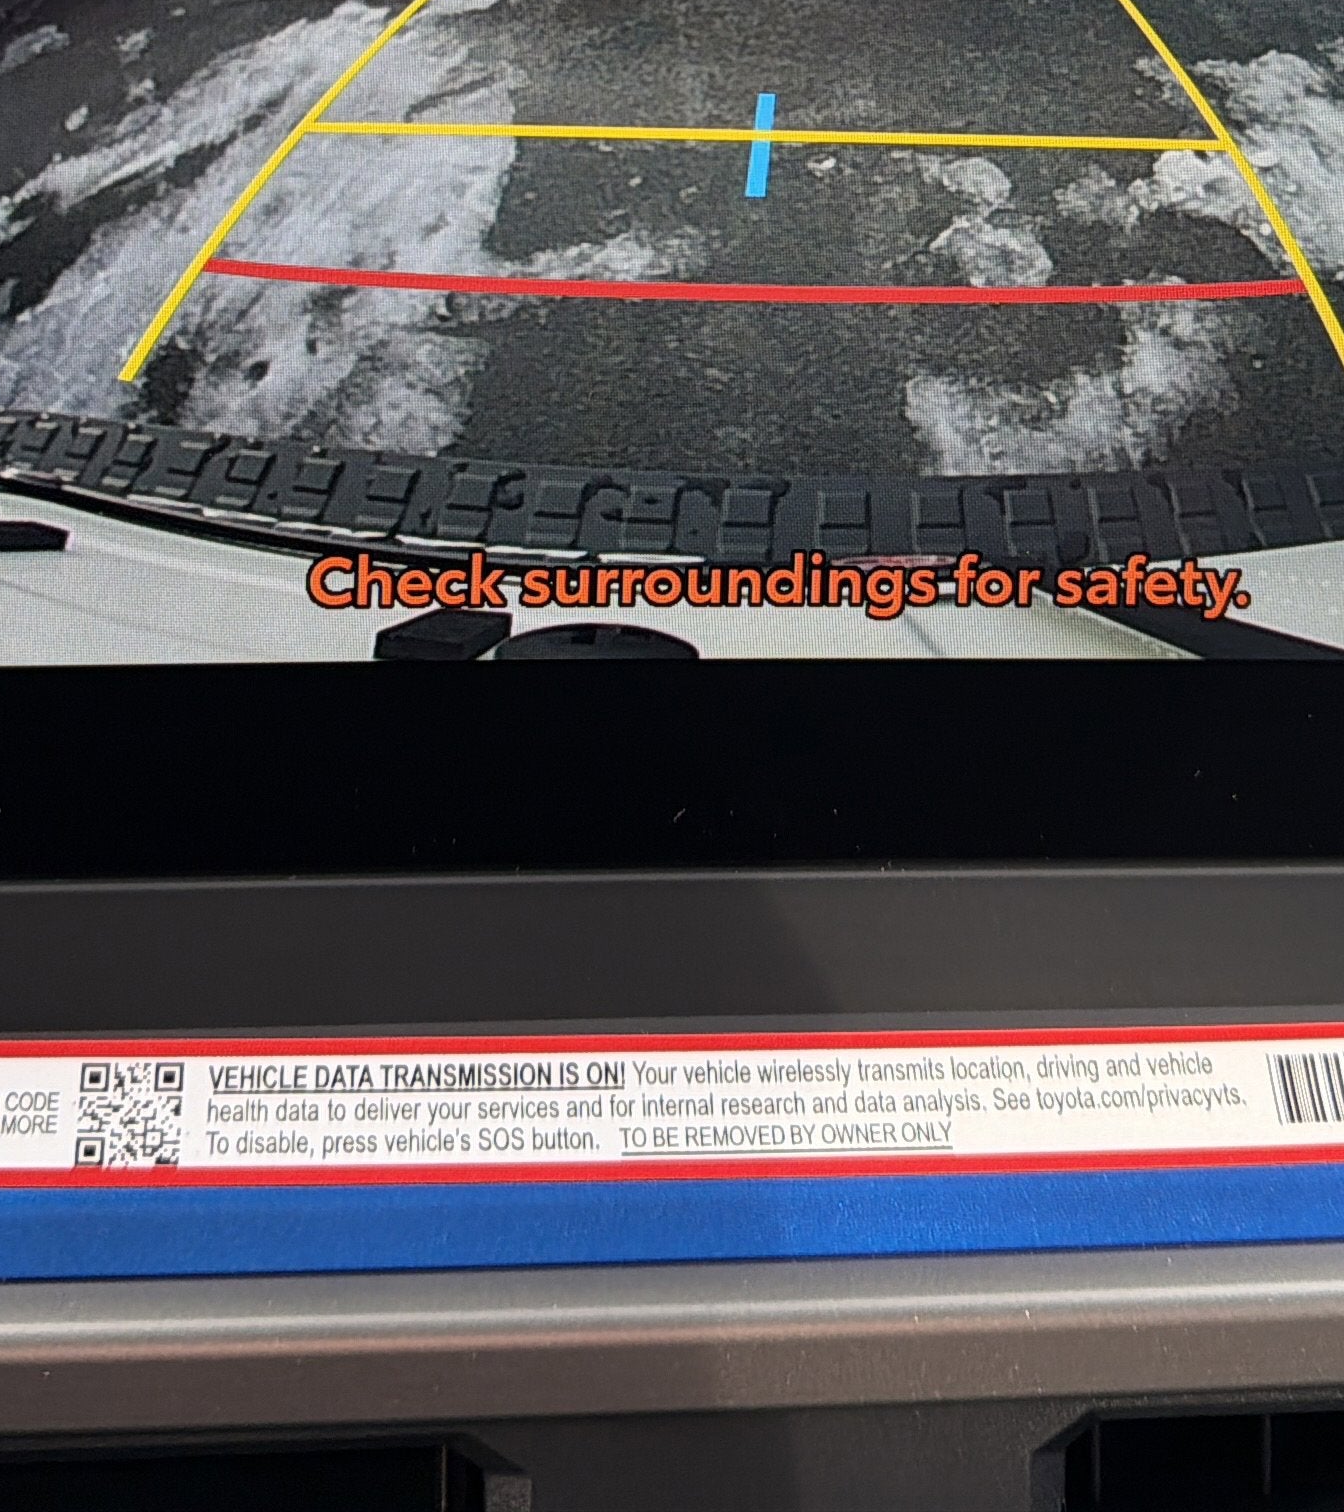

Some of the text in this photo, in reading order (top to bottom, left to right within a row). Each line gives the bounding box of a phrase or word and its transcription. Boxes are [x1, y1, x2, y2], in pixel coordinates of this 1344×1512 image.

[309, 552, 1252, 620] Check surroundings for safety.
[209, 1051, 1213, 1088] VEHICLE DATA TRANSMISSION IS ON! Your vehicle wirelessly transmits location, driving and vehicle
[6, 1091, 60, 1112] CODE
[207, 1083, 1248, 1125] health data to deliver your services and for internal research and data analysis. See toyota.com/privacyvts.
[1, 1114, 58, 1135] MORE
[206, 1120, 952, 1159] To disable, press vehicle's SOS button. TO BE REMOVED BY OWNER ONLY
